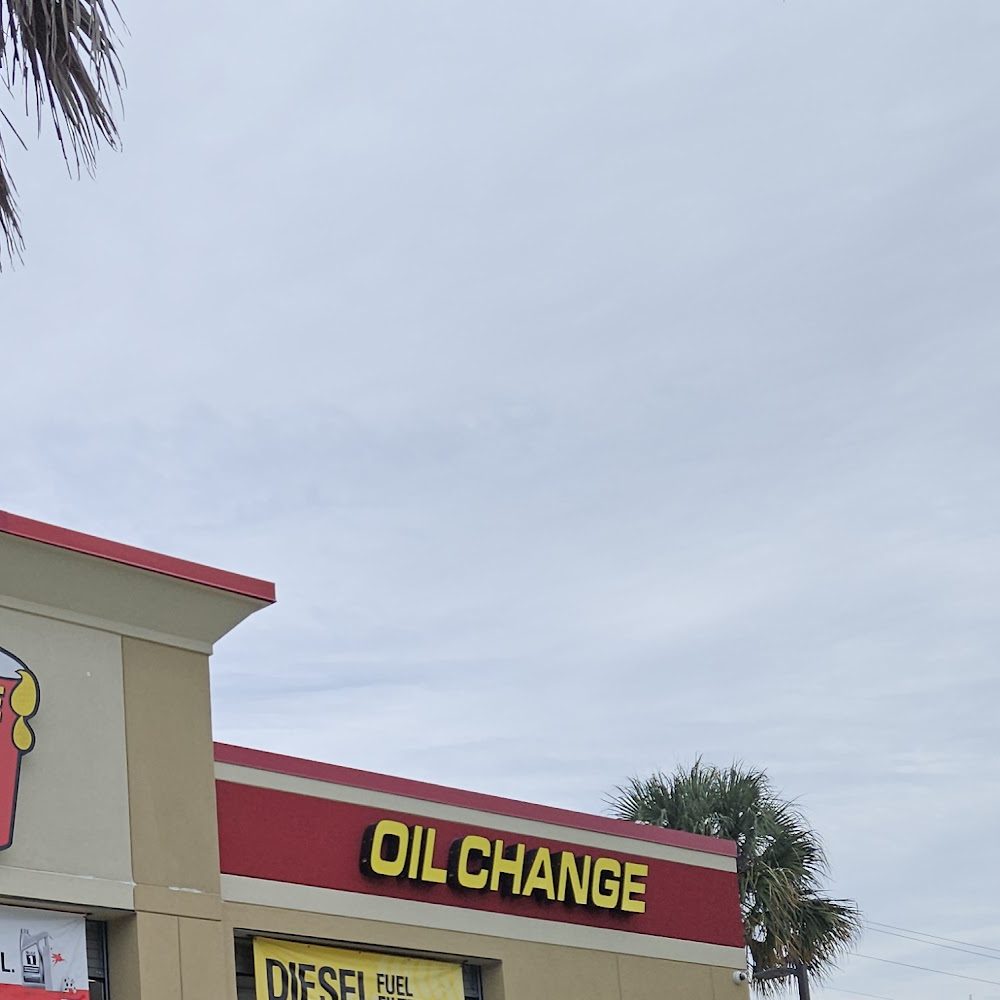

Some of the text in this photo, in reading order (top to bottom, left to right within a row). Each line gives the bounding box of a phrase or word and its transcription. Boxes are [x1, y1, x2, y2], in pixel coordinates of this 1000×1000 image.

[369, 819, 649, 913] OIL CHANGE
[376, 973, 414, 998] FUEL
